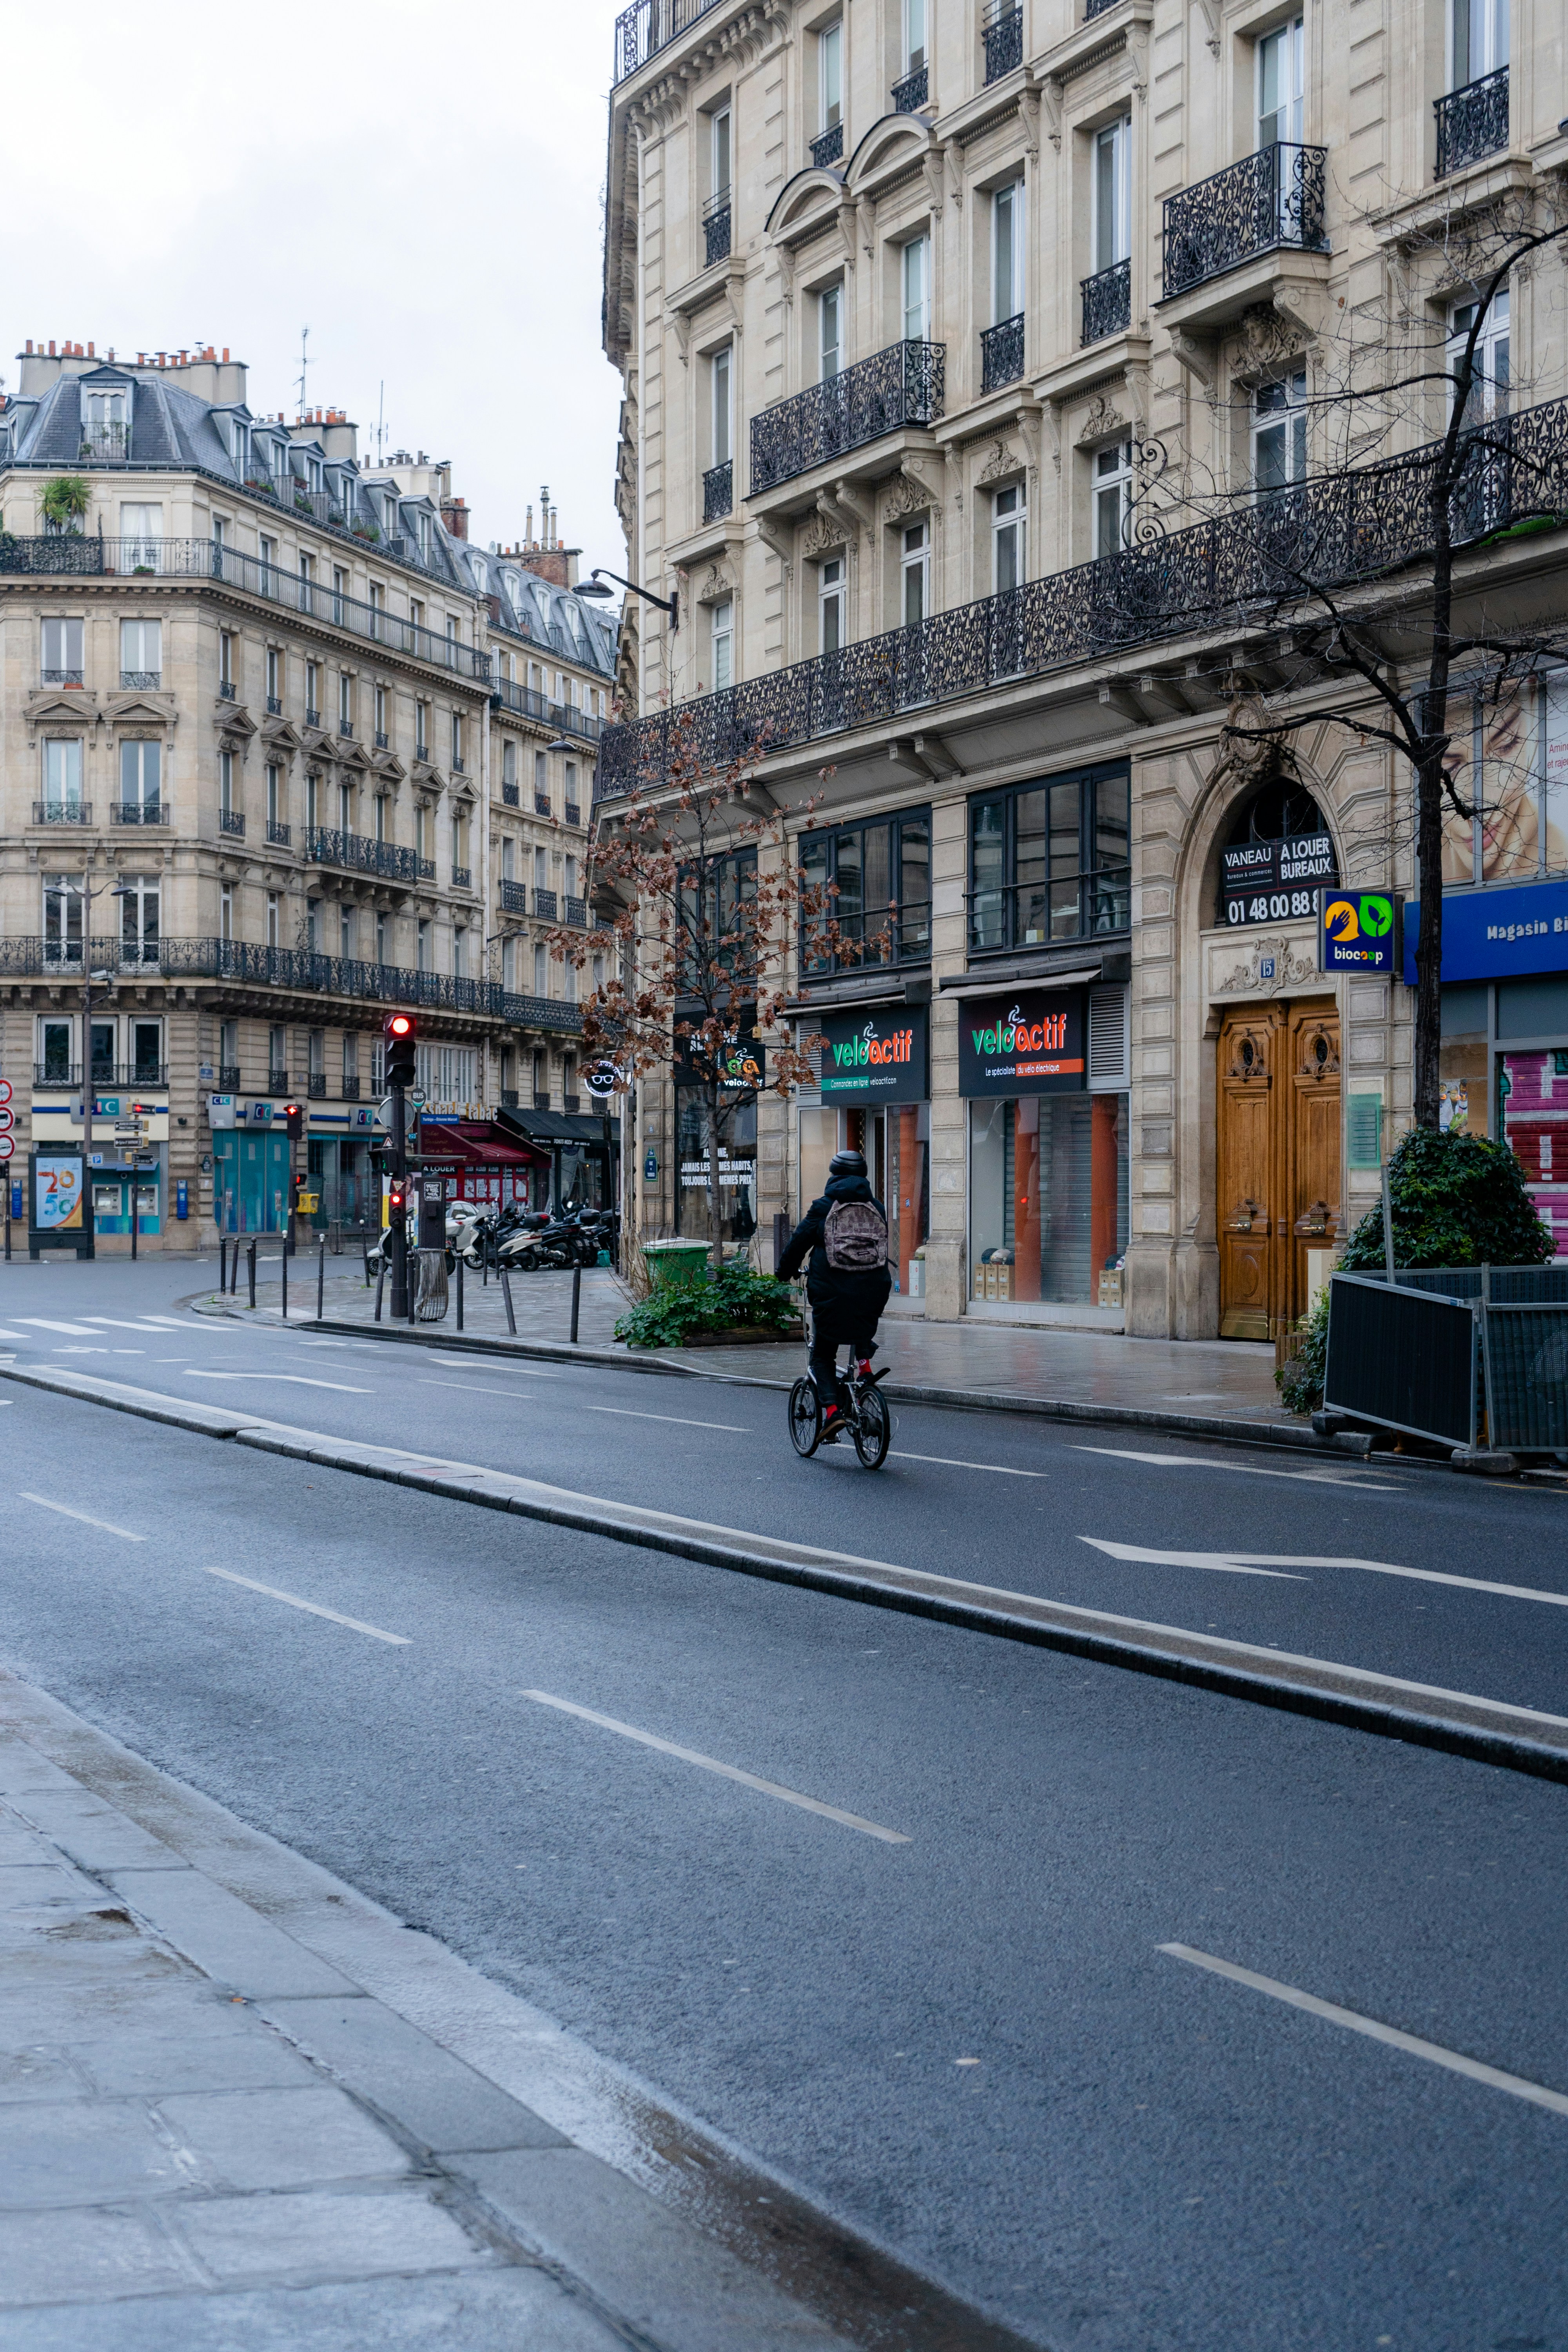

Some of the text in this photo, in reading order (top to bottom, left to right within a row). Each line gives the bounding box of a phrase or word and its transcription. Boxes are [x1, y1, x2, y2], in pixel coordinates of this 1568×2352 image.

[1549, 742, 1568, 753] Amin
[1547, 757, 1568, 769] et raje
[1292, 837, 1330, 859] LOUER
[1225, 848, 1271, 867] VANEAU
[1281, 857, 1331, 879] BUREAUX
[1229, 900, 1245, 923] 01
[1249, 897, 1268, 920] 48
[1270, 894, 1289, 918] 00
[1292, 891, 1310, 915] 88
[1487, 919, 1548, 941] Magasin
[1334, 946, 1383, 965] biocoop
[1263, 960, 1272, 976] 15
[972, 1013, 1066, 1055] veloactif
[833, 1029, 912, 1067] veloactif
[985, 1063, 1060, 1077] Le spécialiste du vélo électrique
[831, 1079, 852, 1088] Commandez
[858, 1078, 868, 1087] ligne
[869, 1076, 897, 1085] veloactif.com
[256, 1106, 270, 1118] CIC
[359, 1112, 371, 1122] CIC
[466, 1103, 498, 1121] tabac
[681, 1162, 700, 1172] JAMAIS
[701, 1162, 710, 1172] LES
[731, 1161, 752, 1172] HABITS,
[681, 1176, 707, 1186] TOUJOURS
[739, 1175, 752, 1185] PRIX
